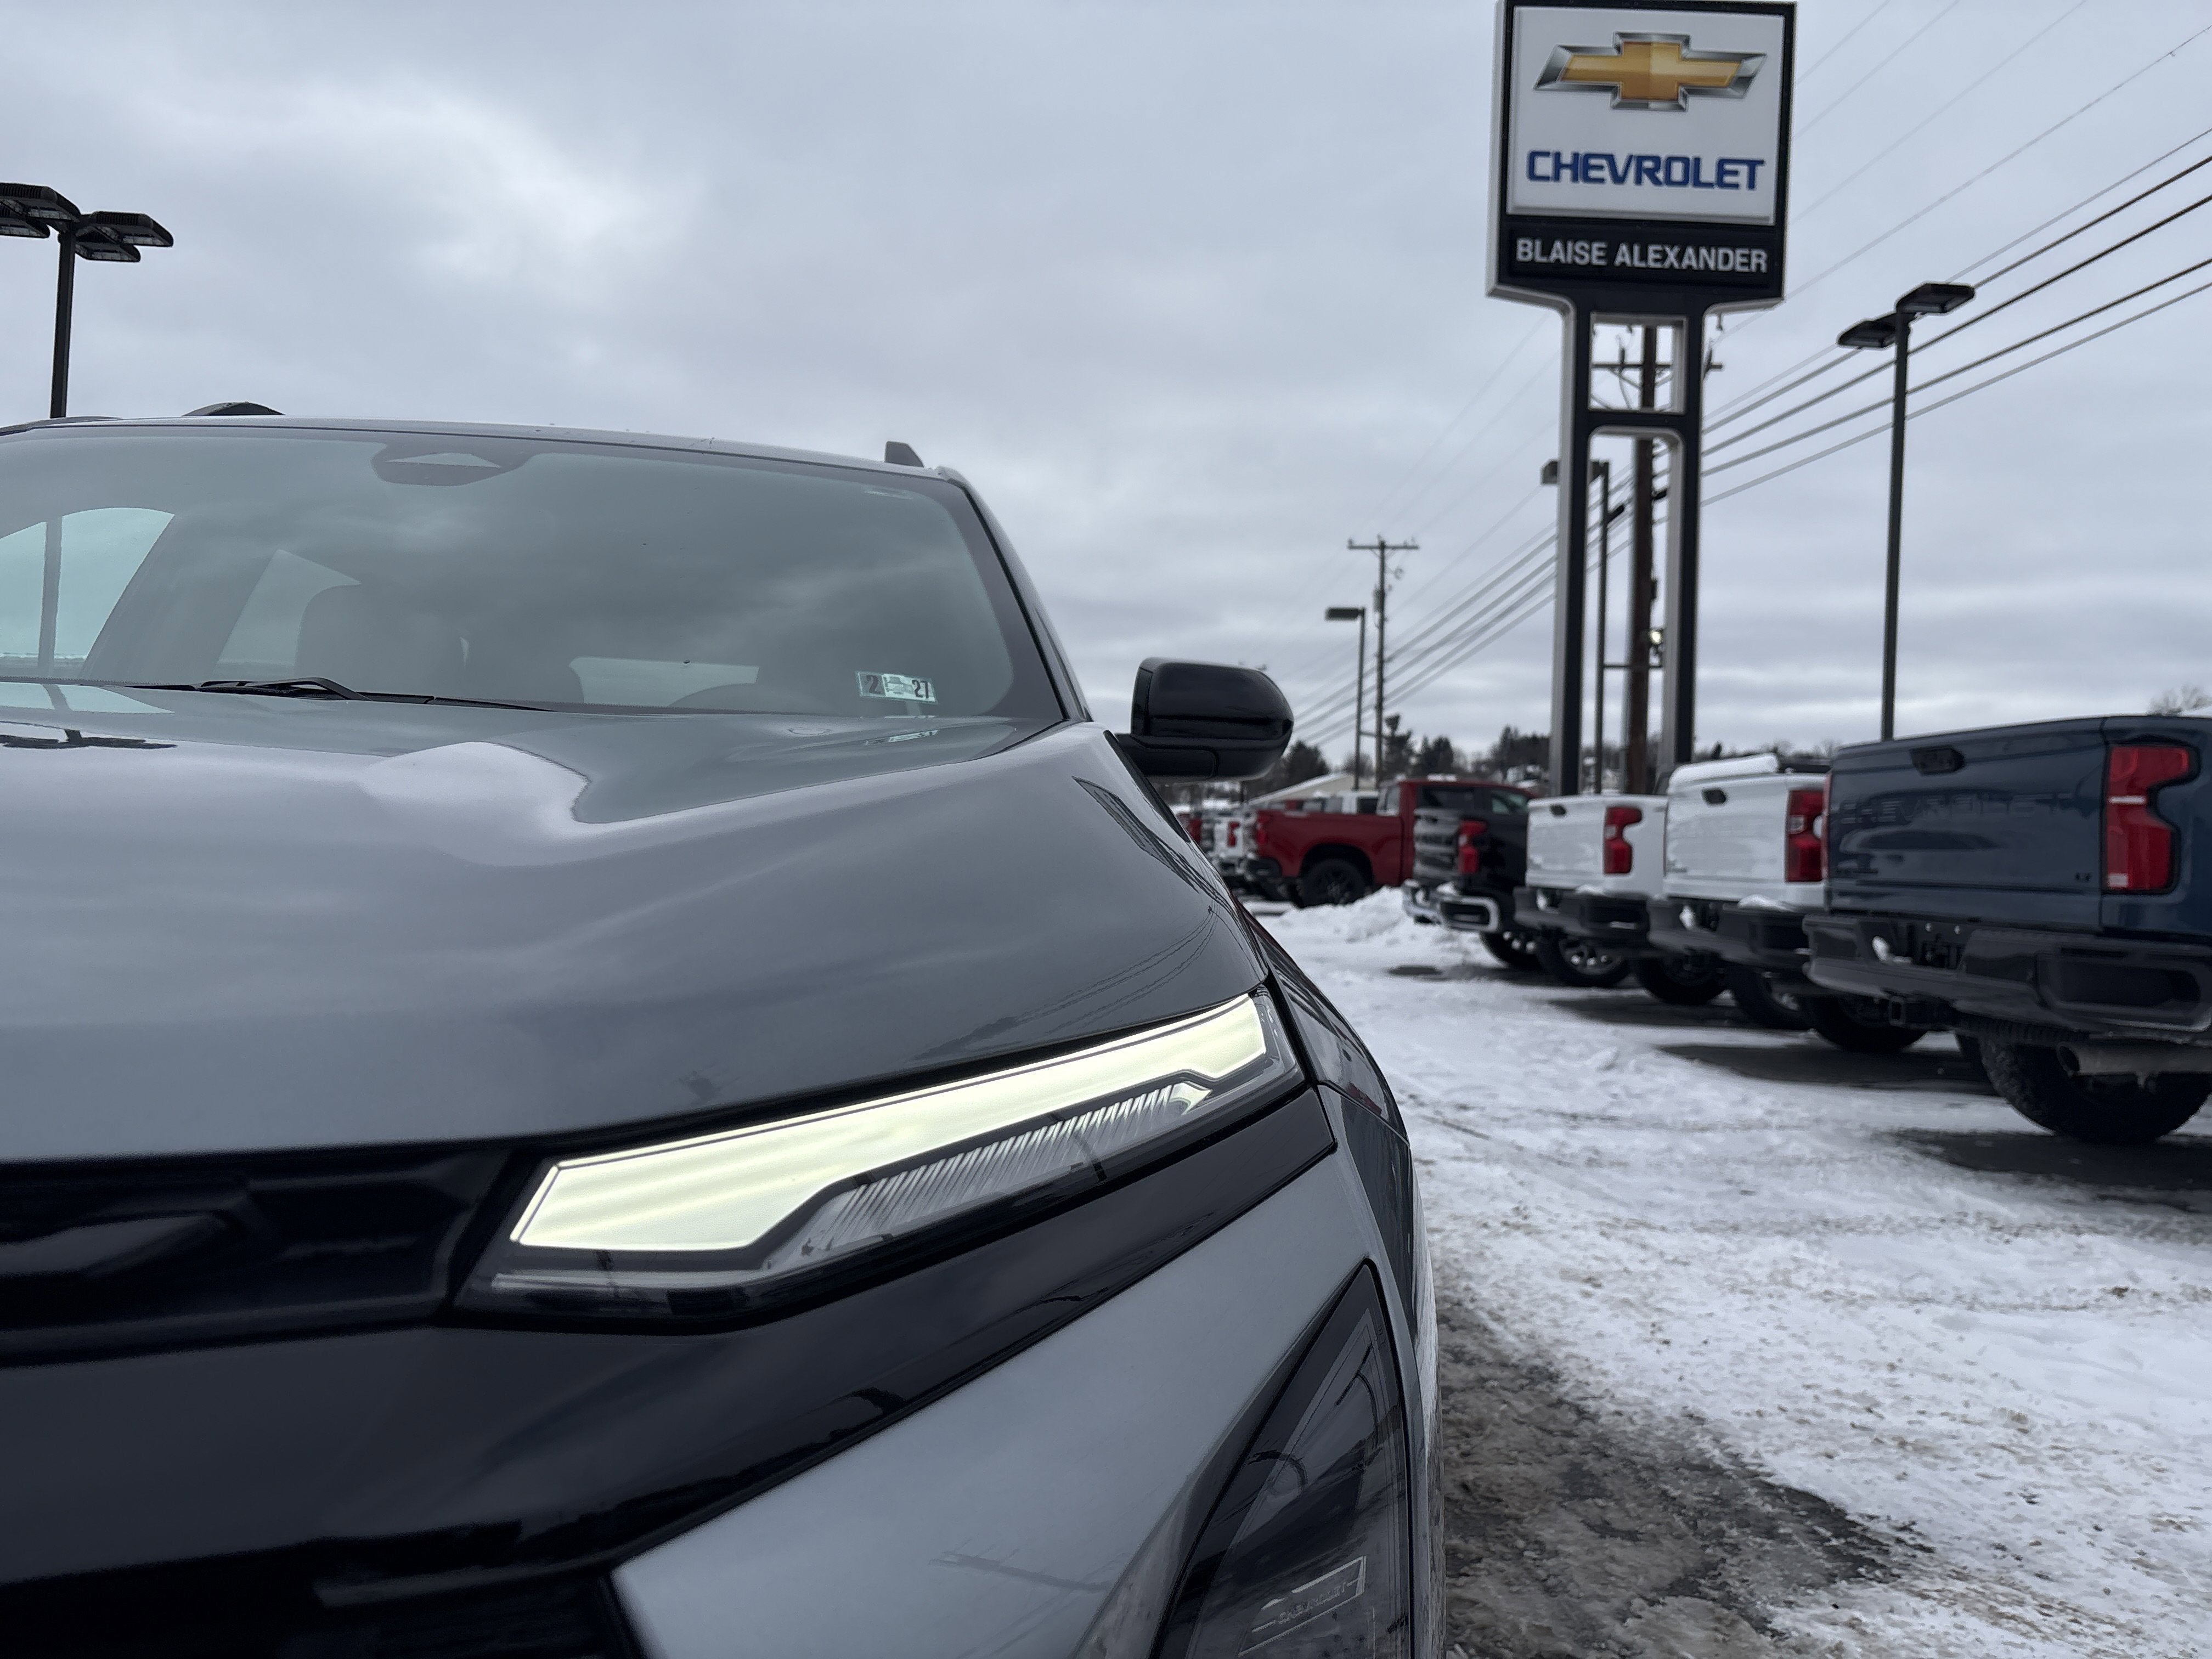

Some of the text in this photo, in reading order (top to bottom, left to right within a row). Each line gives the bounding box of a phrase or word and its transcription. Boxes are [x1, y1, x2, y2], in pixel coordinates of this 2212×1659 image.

[1527, 150, 1766, 191] CHEVROLET
[1516, 236, 1768, 273] BLAISE ALEXANDER
[866, 674, 882, 694] 2
[911, 679, 929, 699] 27
